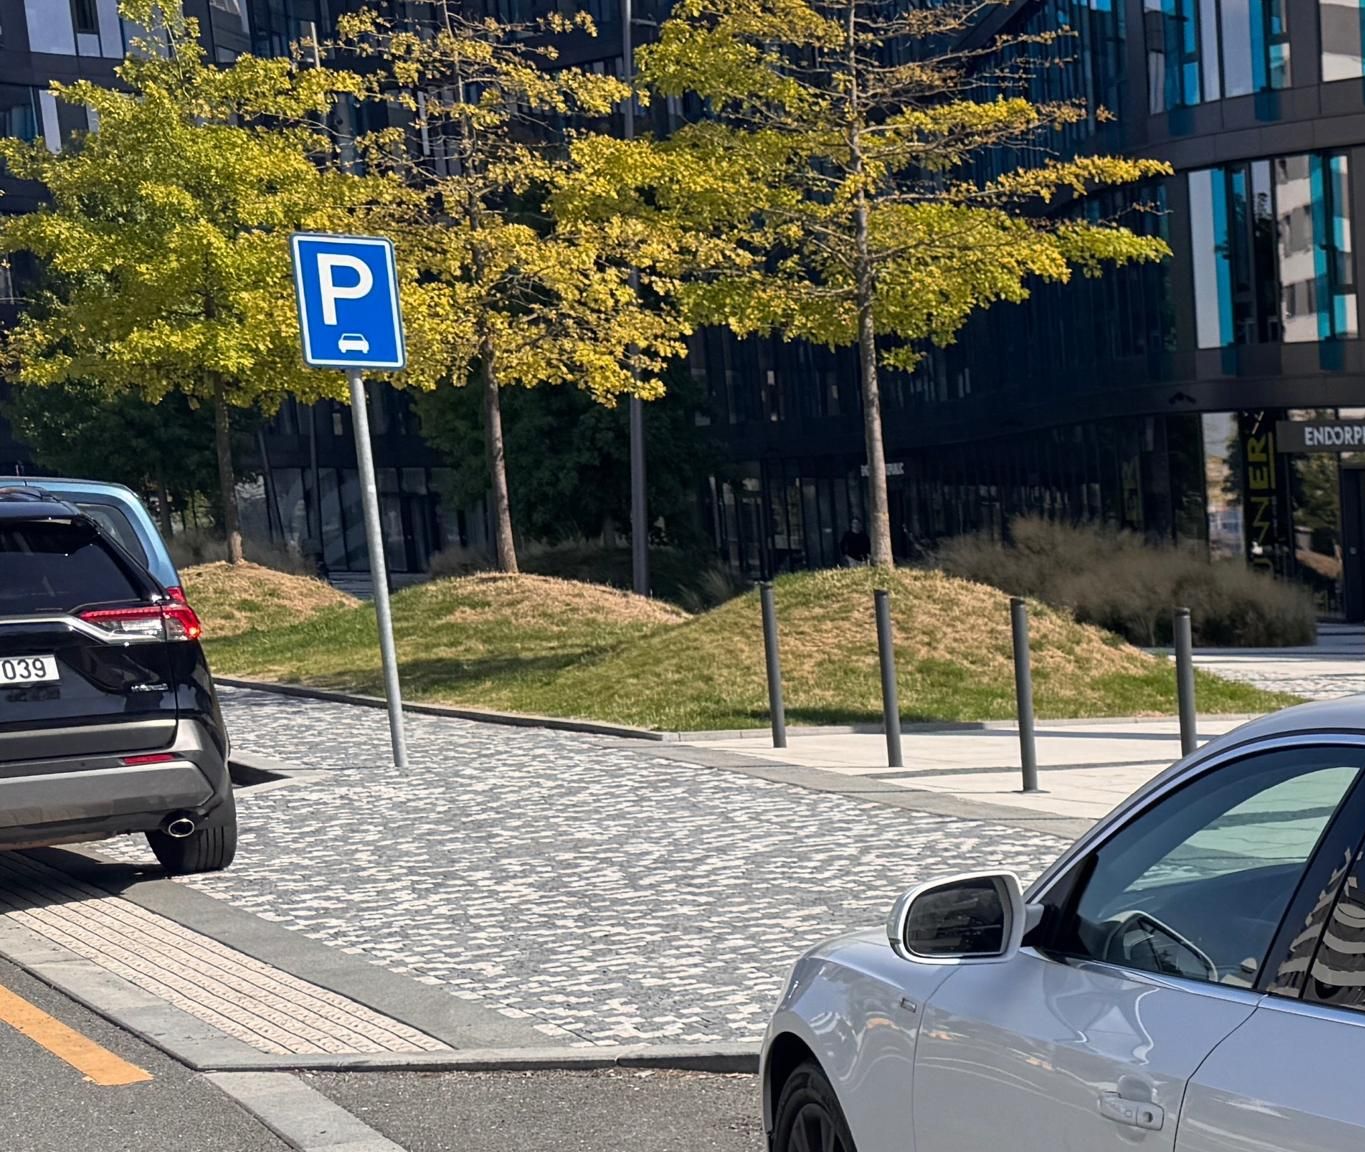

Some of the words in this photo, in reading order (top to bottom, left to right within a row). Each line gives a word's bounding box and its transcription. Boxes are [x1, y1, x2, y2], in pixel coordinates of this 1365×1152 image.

[316, 252, 374, 327] P
[1246, 434, 1271, 574] UNNER
[1, 657, 47, 681] 039
